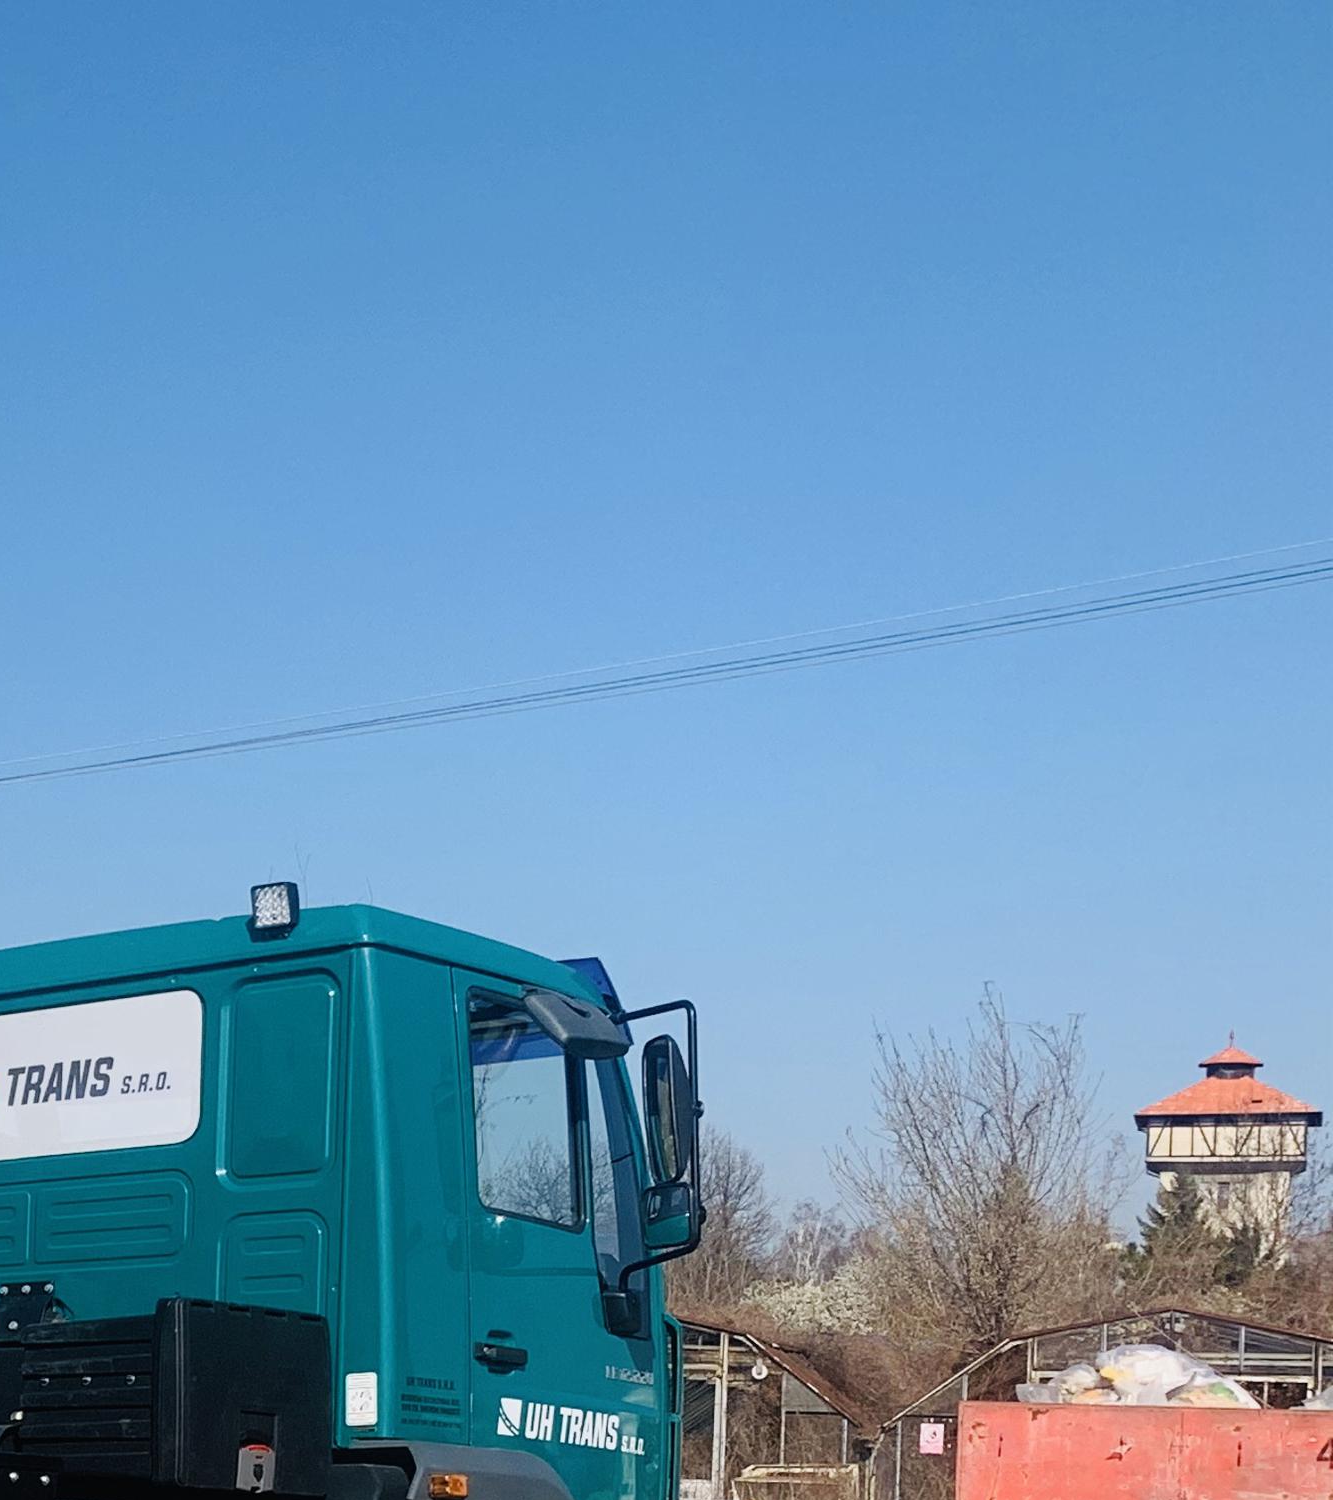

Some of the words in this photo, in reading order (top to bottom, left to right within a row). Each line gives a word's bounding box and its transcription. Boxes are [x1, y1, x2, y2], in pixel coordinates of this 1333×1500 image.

[7, 1056, 114, 1106] TRANS
[120, 1071, 171, 1094] S.R.O.
[525, 1402, 555, 1441] UH
[559, 1407, 620, 1450] TRANS
